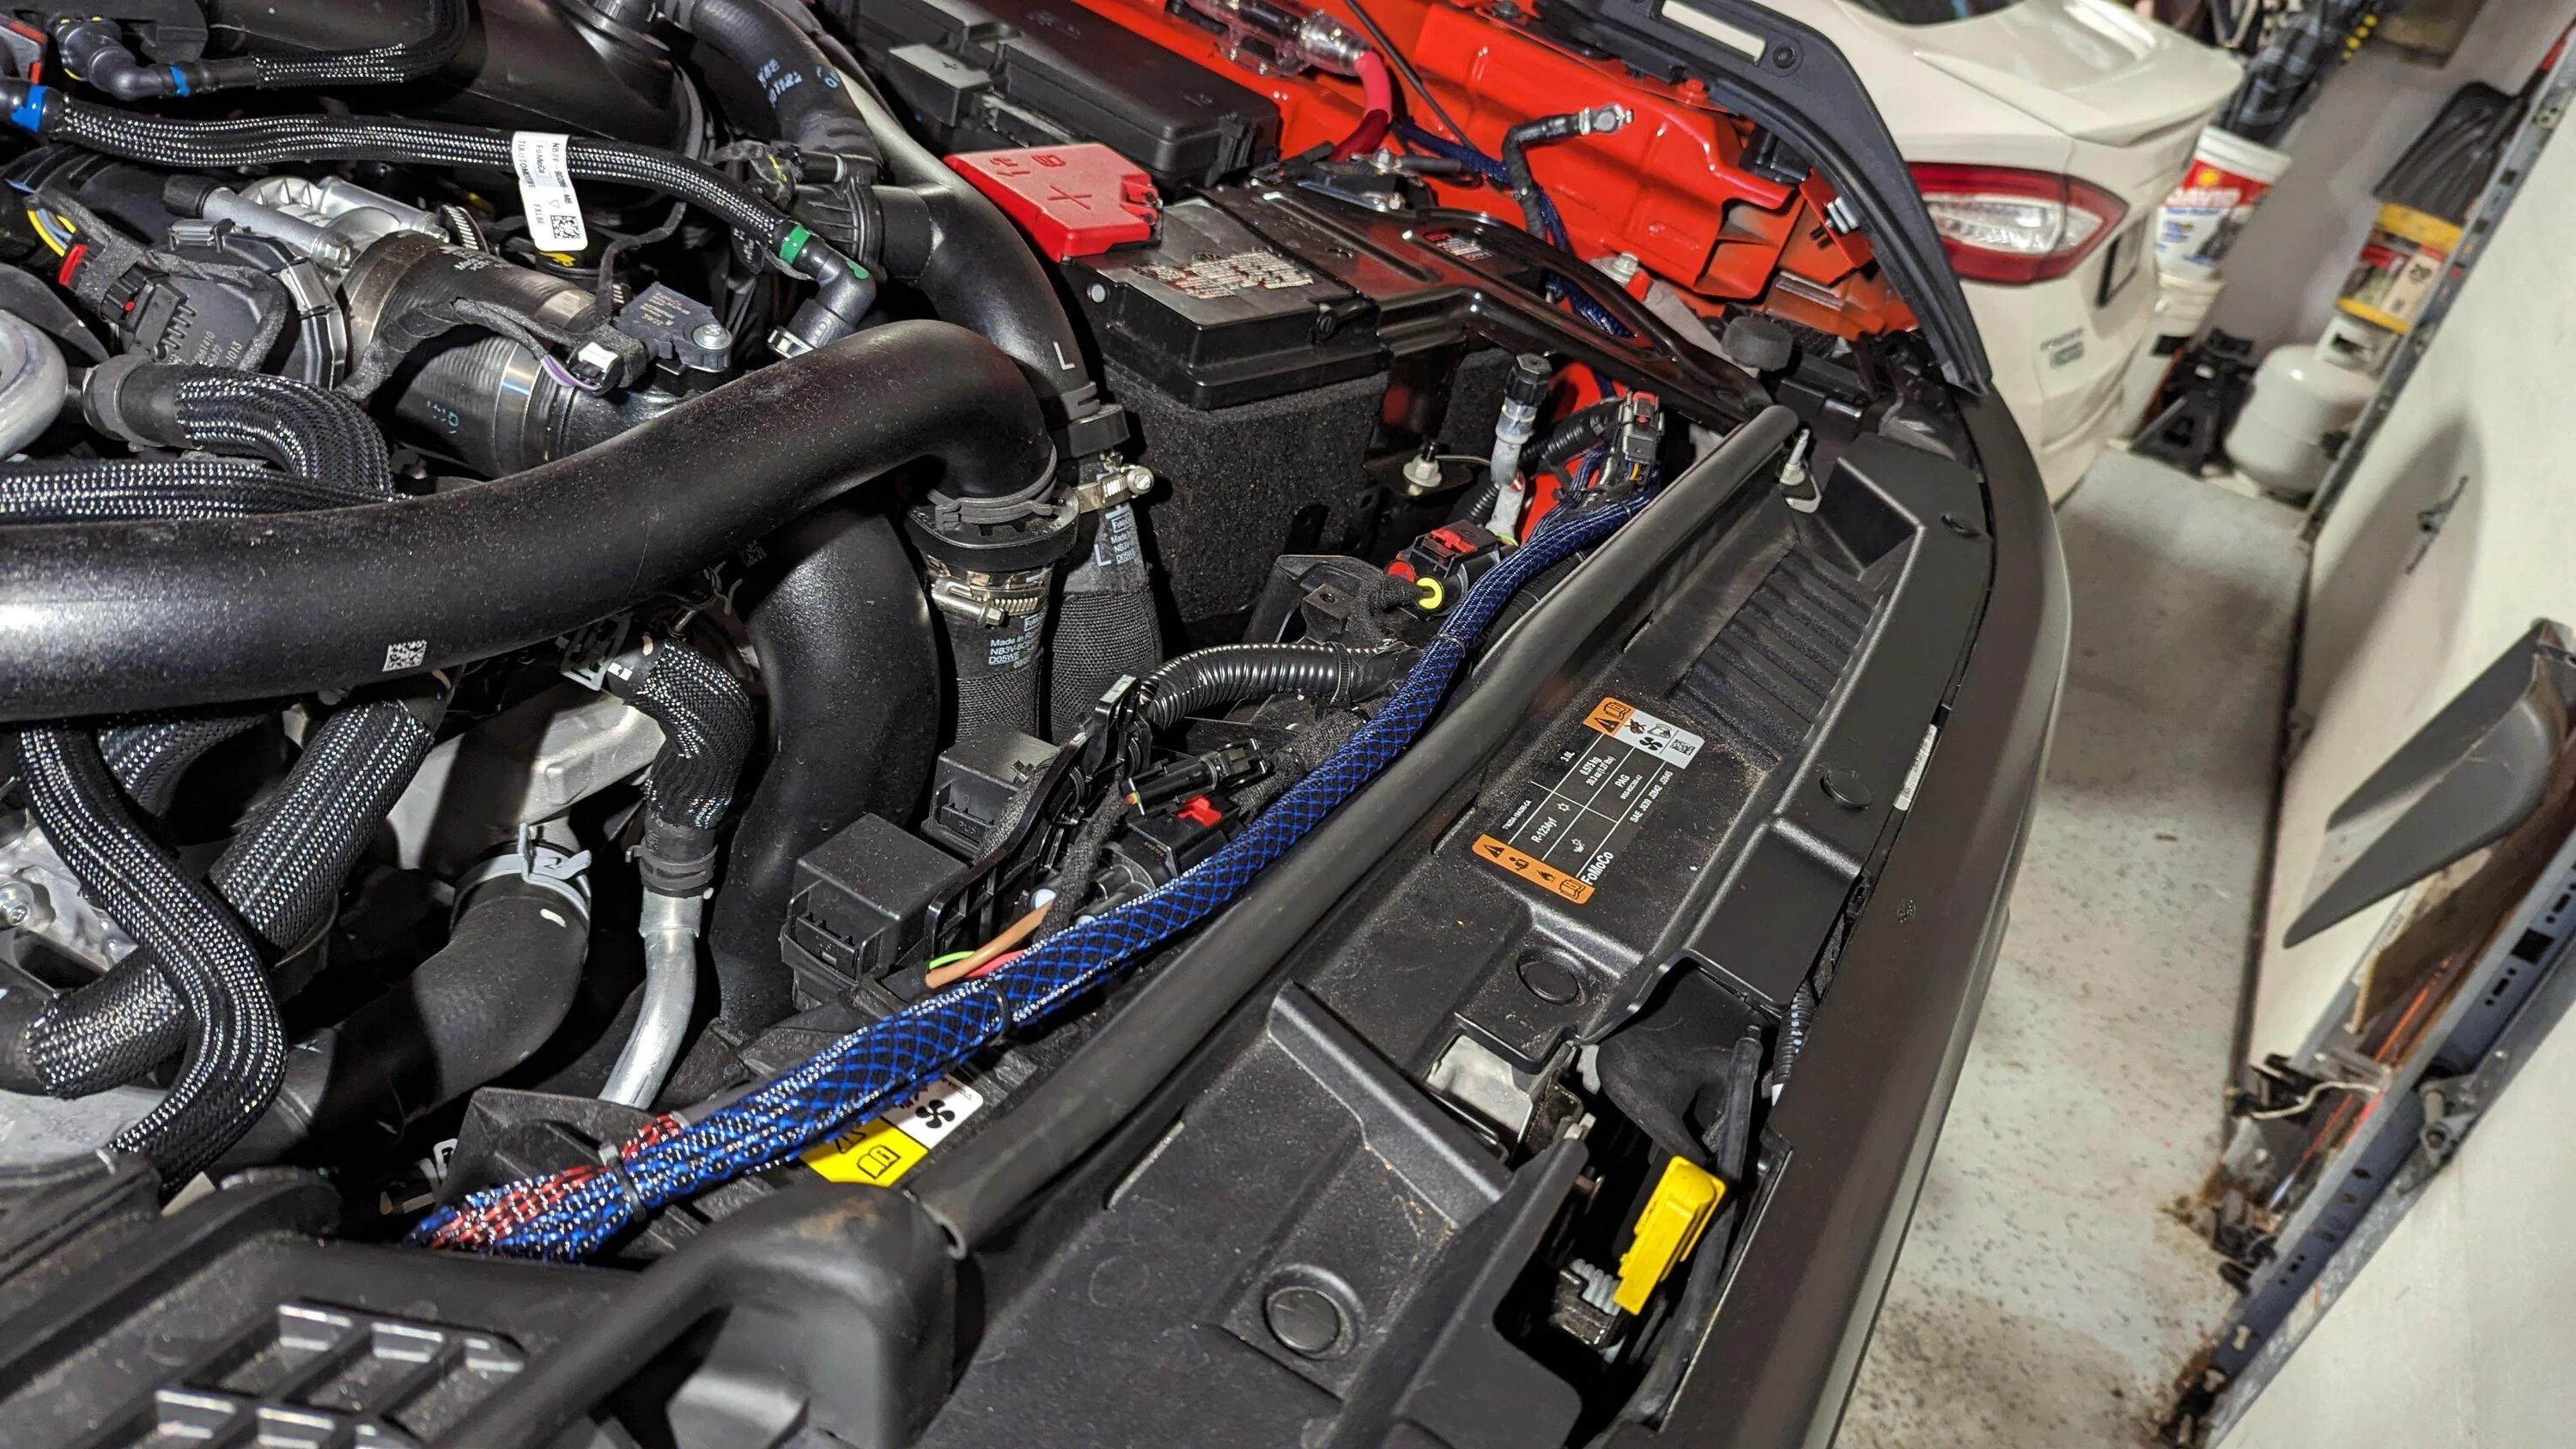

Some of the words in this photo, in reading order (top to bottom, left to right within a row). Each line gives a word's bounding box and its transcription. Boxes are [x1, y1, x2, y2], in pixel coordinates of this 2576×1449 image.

[536, 144, 546, 174] FoMoCo
[1053, 341, 1076, 370] L
[1094, 543, 1112, 567] L
[990, 638, 1016, 647] Made
[1017, 634, 1024, 643] in
[1560, 750, 1576, 762] 3.0L
[1580, 760, 1595, 775] 0.575
[1614, 773, 1631, 787] PAG
[1630, 809, 1643, 822] SAE
[1639, 798, 1652, 811] J639
[1531, 815, 1558, 844] R-1234yf
[1580, 851, 1614, 886] FoMoCo
